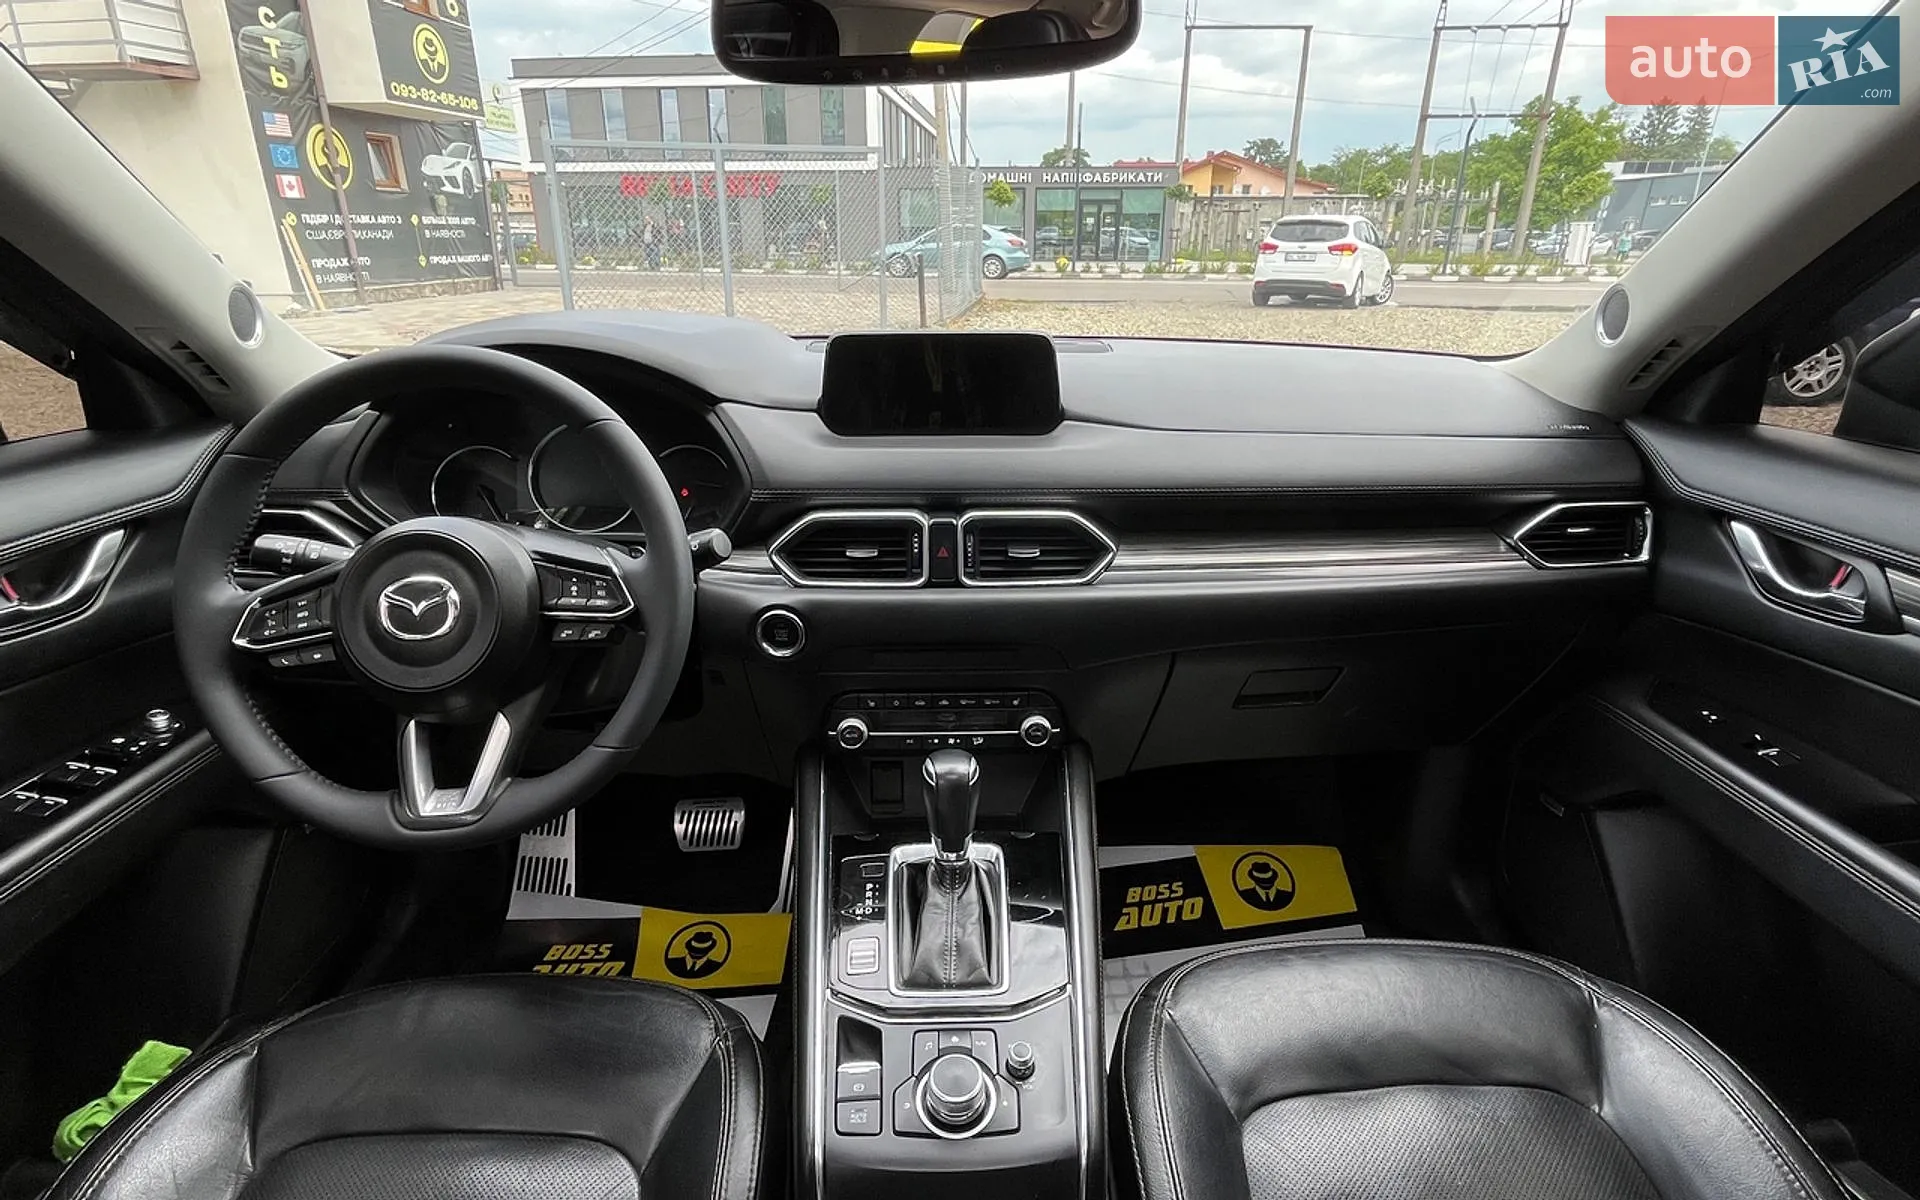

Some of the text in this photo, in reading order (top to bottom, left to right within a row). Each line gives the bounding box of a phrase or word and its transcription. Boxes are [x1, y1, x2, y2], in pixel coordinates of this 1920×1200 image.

[1126, 881, 1184, 904] BOSS
[1113, 896, 1204, 931] AUTO
[543, 943, 613, 961] BOSS
